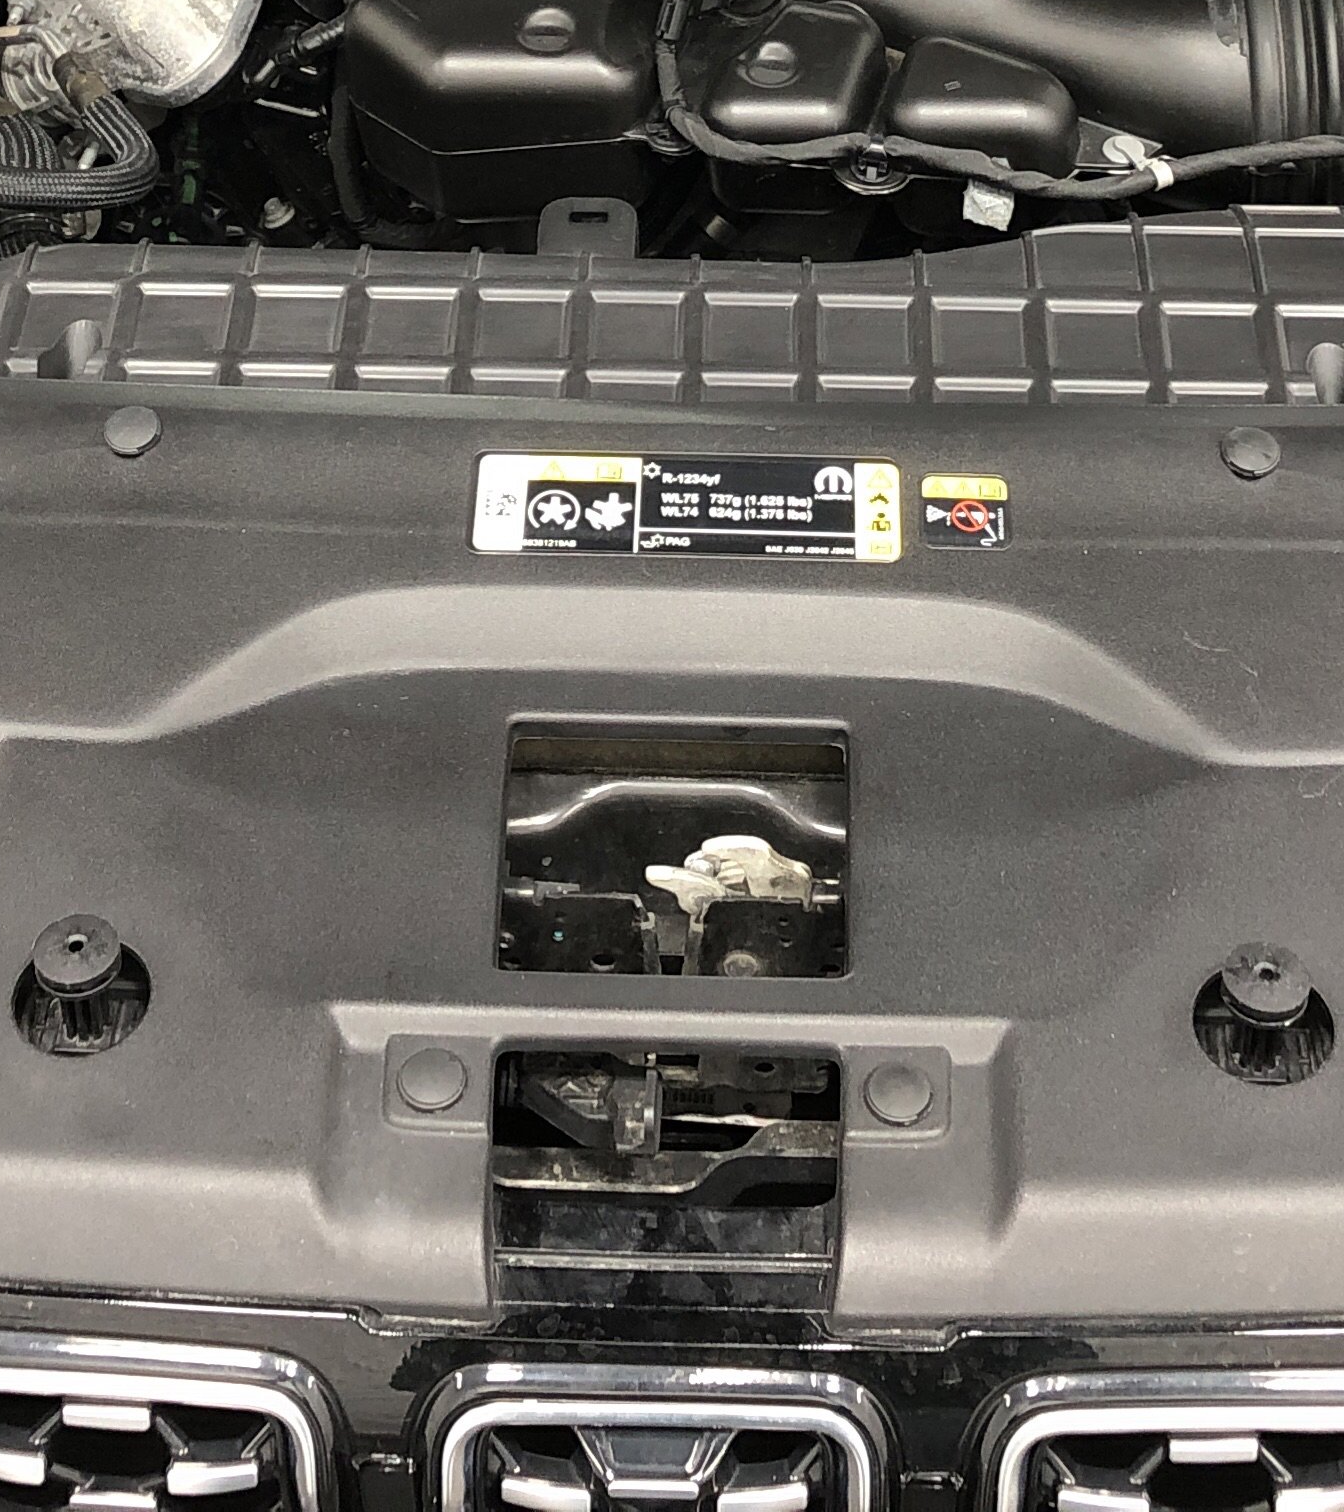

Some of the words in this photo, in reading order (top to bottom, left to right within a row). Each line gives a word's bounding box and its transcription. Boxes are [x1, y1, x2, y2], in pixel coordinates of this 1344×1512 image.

[662, 473, 721, 487] R-1234yf
[661, 493, 699, 504] WL75
[709, 493, 741, 507] 737g
[661, 506, 699, 517] WL74
[709, 507, 741, 521] 624g
[744, 508, 784, 521] (1.375
[665, 536, 691, 547] PAG
